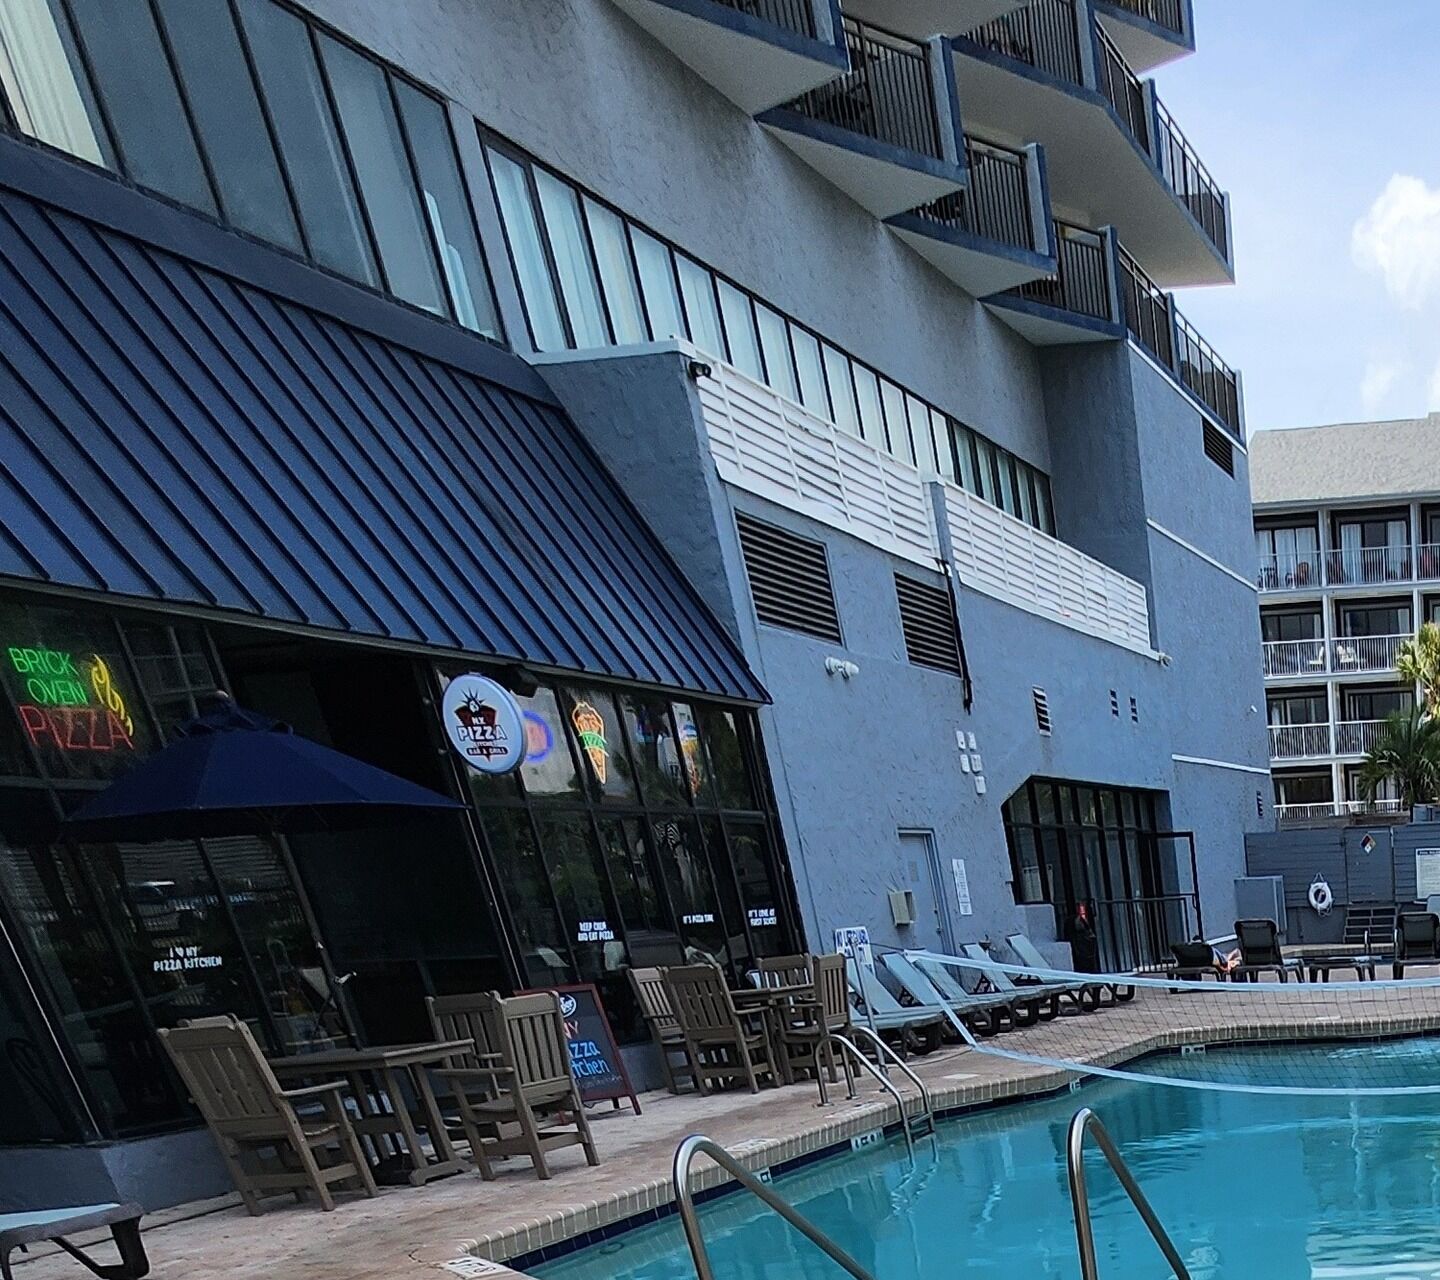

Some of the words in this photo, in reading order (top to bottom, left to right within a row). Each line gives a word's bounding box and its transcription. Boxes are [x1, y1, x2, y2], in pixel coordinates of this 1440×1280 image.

[9, 647, 80, 677] BRICK
[27, 678, 89, 705] OVEN
[19, 705, 134, 749] PIZZA
[456, 725, 507, 741] PIZZA
[169, 947, 174, 958] I
[185, 946, 197, 957] NY
[153, 959, 182, 972] PIZZA
[184, 956, 222, 969] KITCHEN
